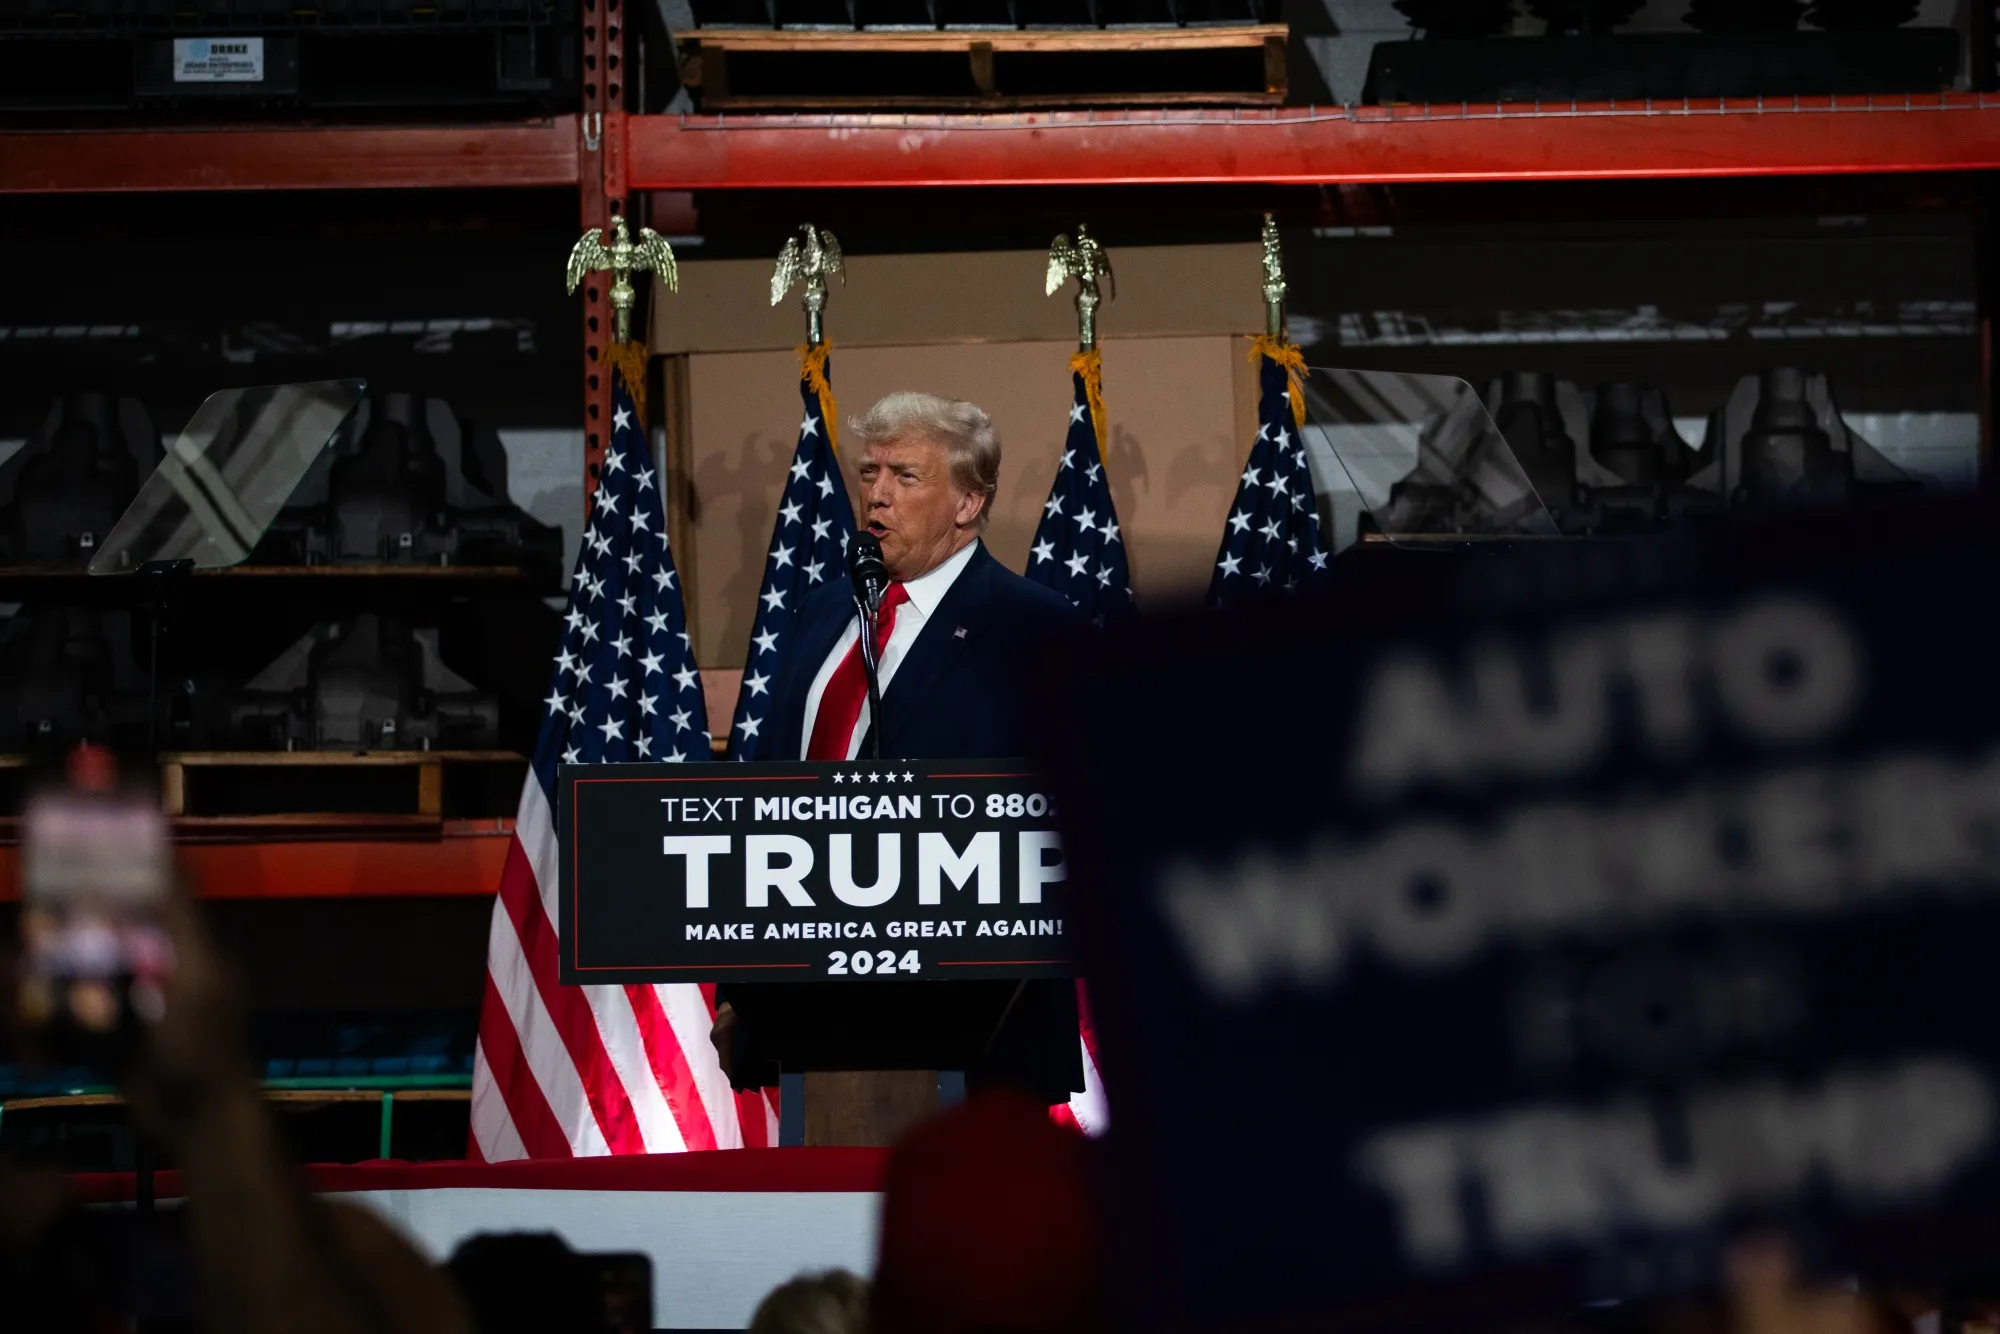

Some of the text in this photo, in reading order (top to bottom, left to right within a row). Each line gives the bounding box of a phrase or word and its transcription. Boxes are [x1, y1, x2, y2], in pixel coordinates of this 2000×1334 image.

[1352, 598, 1862, 796] AUTO
[660, 797, 744, 822] TEXT
[754, 794, 921, 821] MICHIGAN
[931, 793, 975, 819] TO
[663, 831, 1068, 909] TRUMP
[1158, 735, 2000, 998] WORKER
[685, 919, 1063, 941] MAKE AMERICA GREAT AGAIN!
[827, 949, 921, 975] 2024
